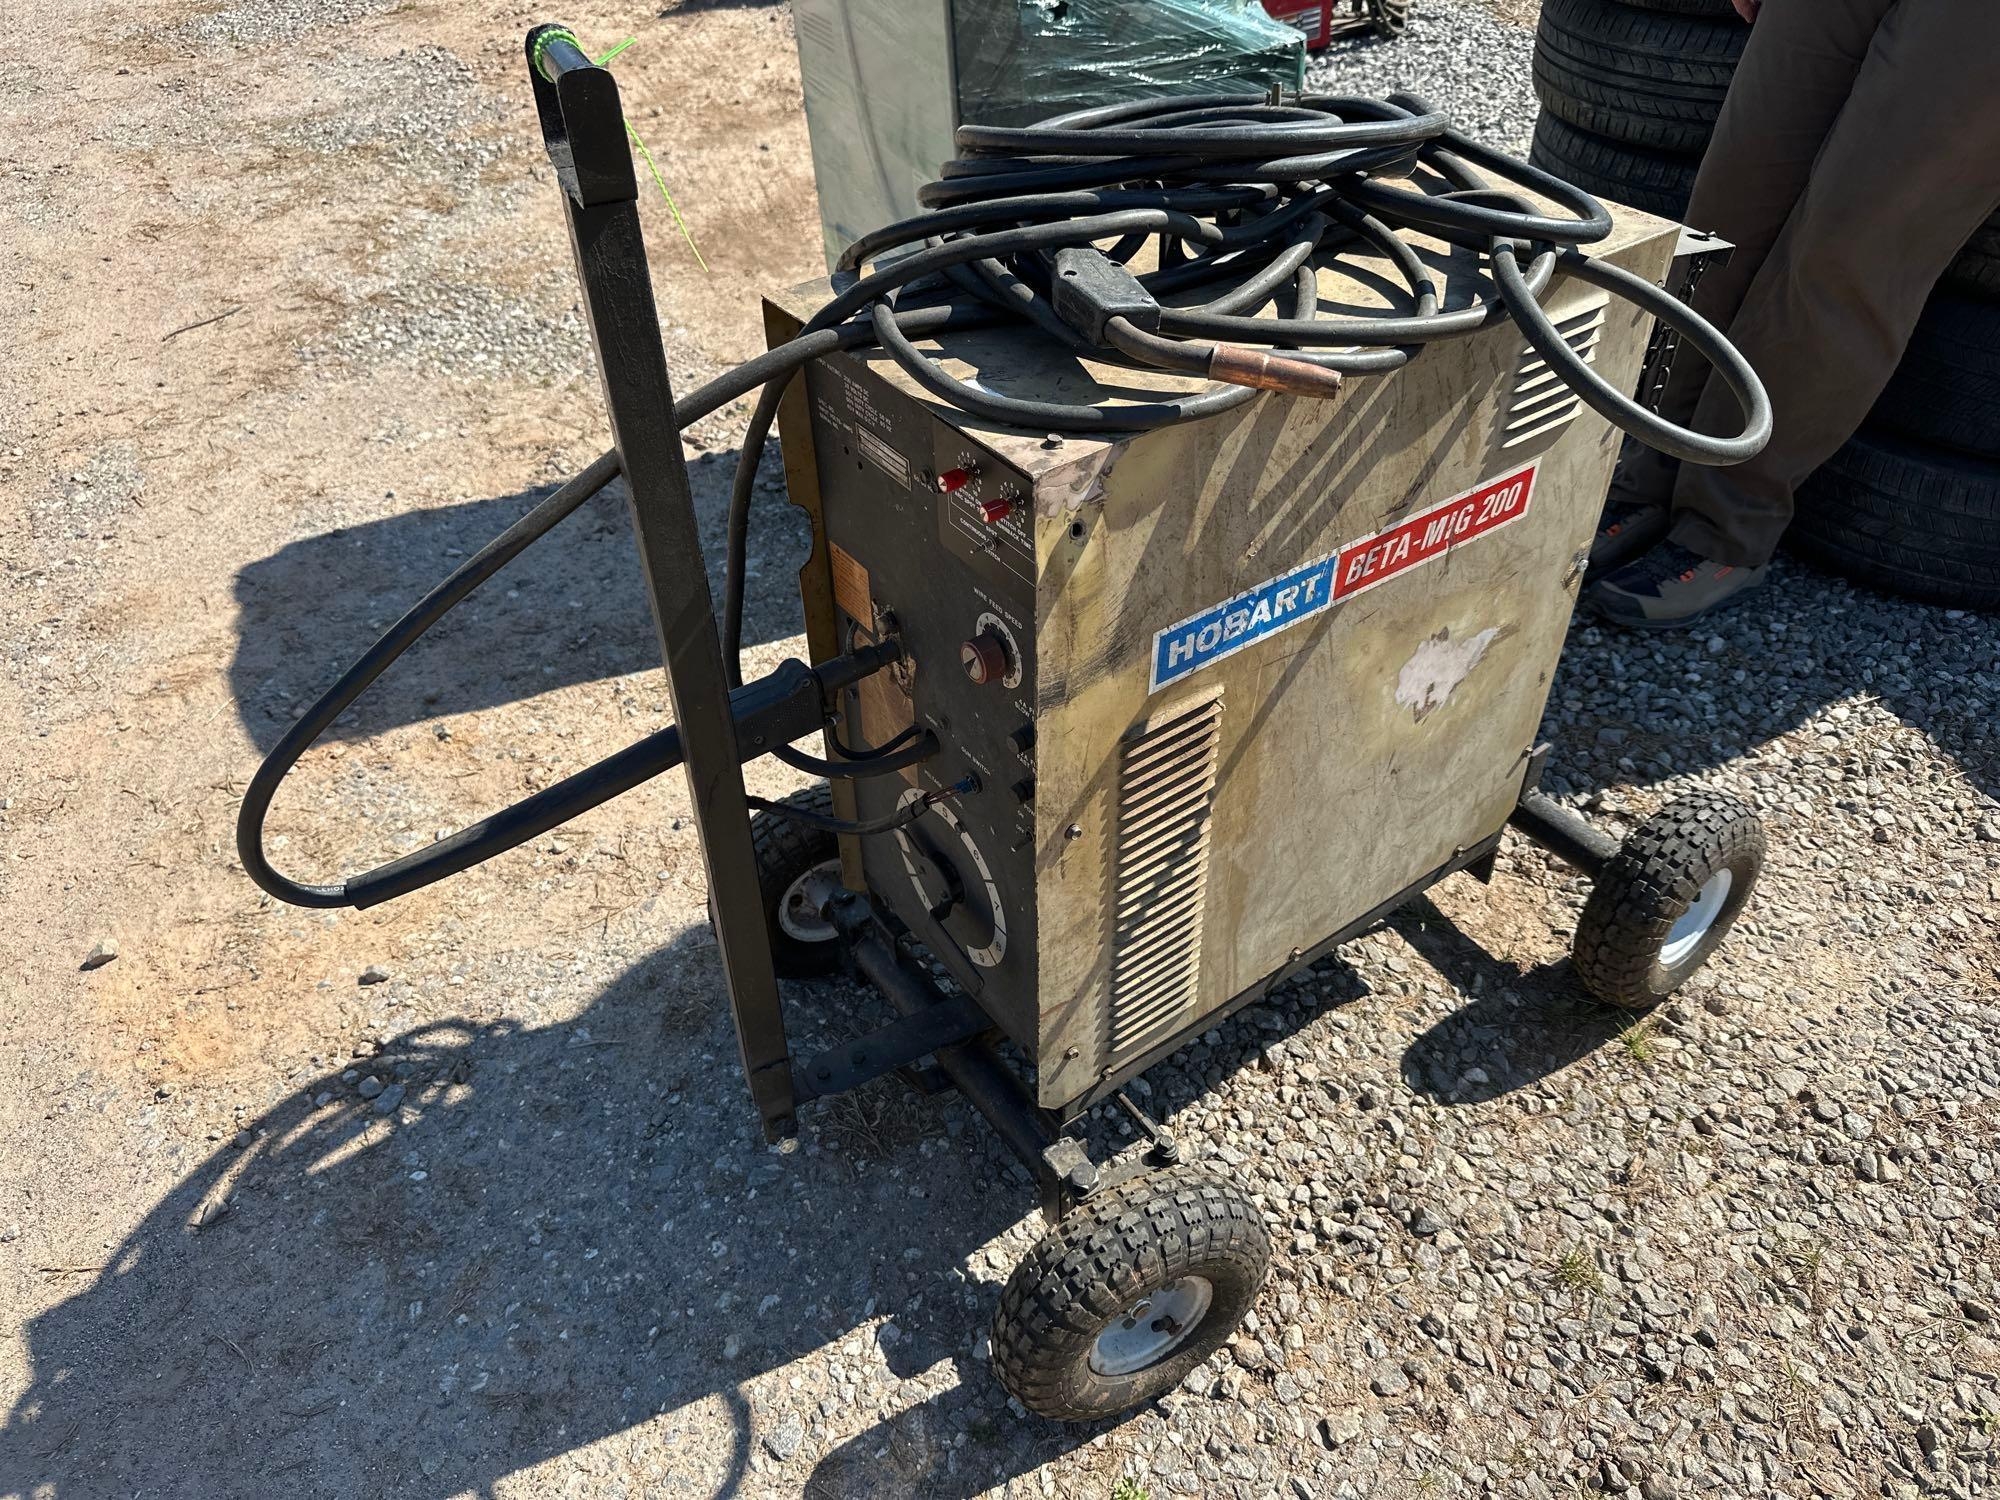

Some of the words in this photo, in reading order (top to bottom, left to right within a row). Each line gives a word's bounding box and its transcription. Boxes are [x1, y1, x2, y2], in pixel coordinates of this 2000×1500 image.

[960, 517, 987, 542] CONTINUOUS
[1344, 505, 1475, 586] BETA-MIG
[1475, 480, 1523, 526] 200
[1167, 574, 1322, 669] HOBART
